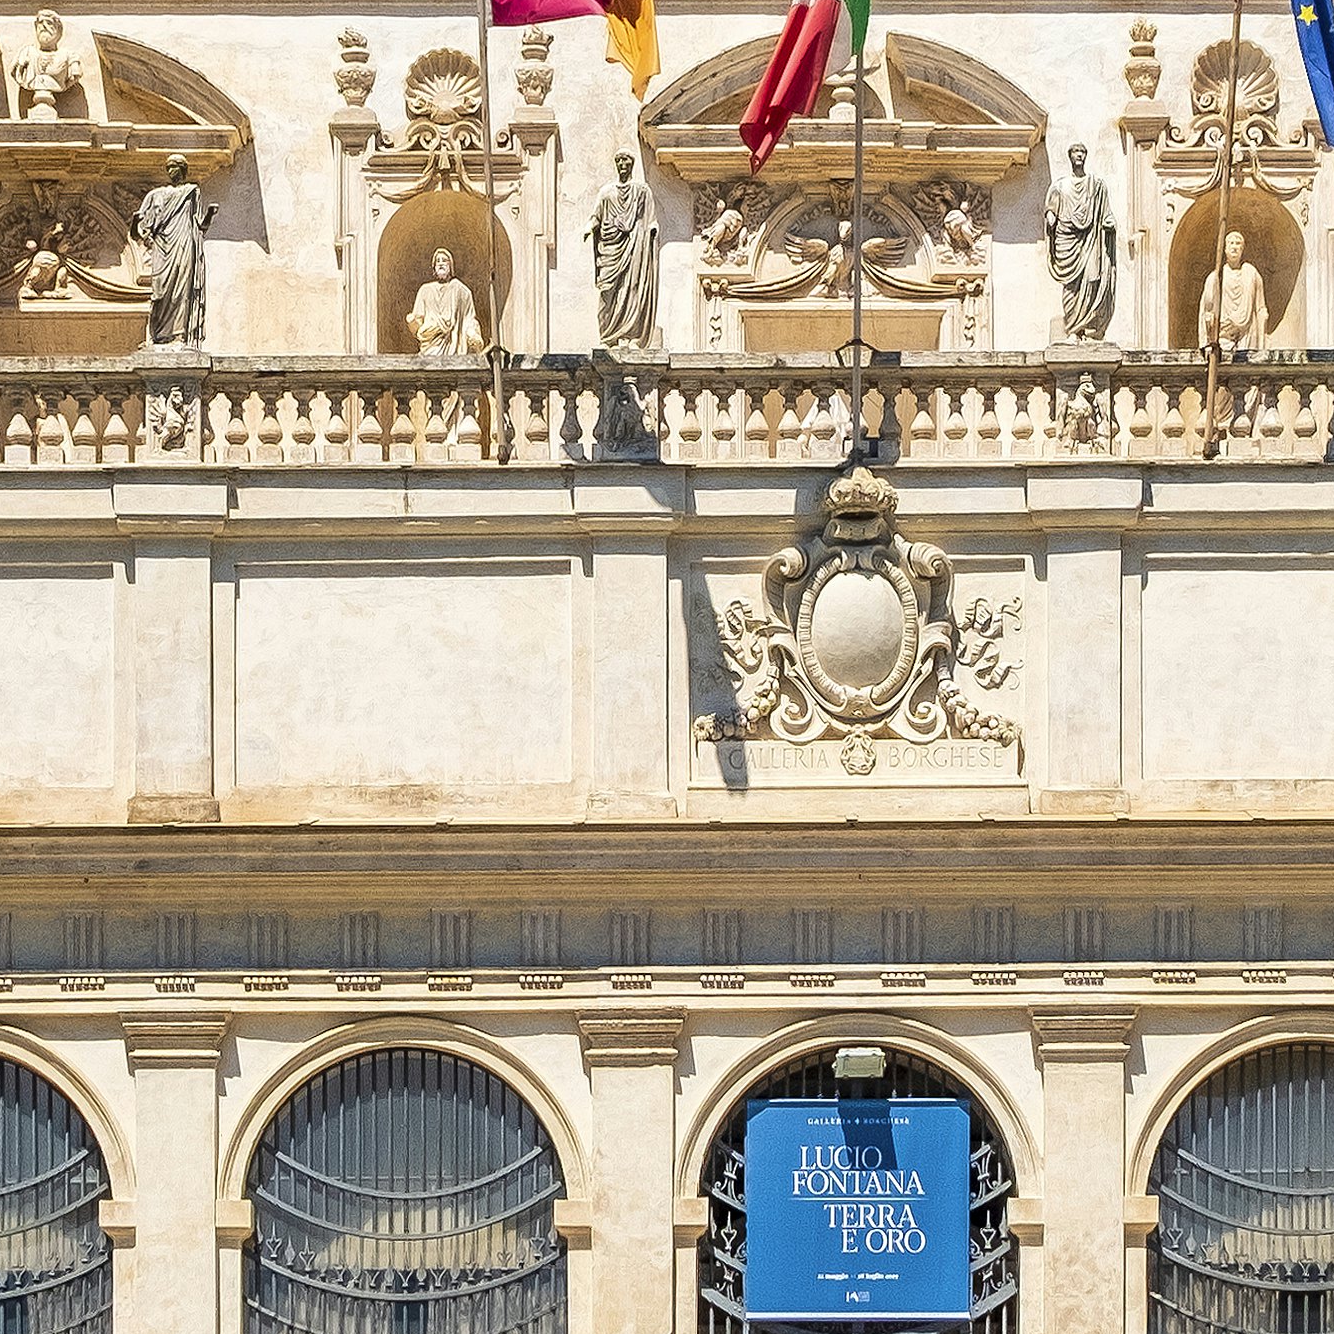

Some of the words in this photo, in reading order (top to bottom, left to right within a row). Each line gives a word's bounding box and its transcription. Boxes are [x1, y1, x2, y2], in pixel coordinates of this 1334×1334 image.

[728, 746, 829, 769] GALLERIA
[888, 745, 1004, 768] BORGHESE
[800, 1145, 882, 1170] LUCIO
[792, 1170, 926, 1195] FONTANA
[823, 1204, 918, 1228] TERRA
[841, 1228, 859, 1253] E
[865, 1228, 926, 1253] ORO
